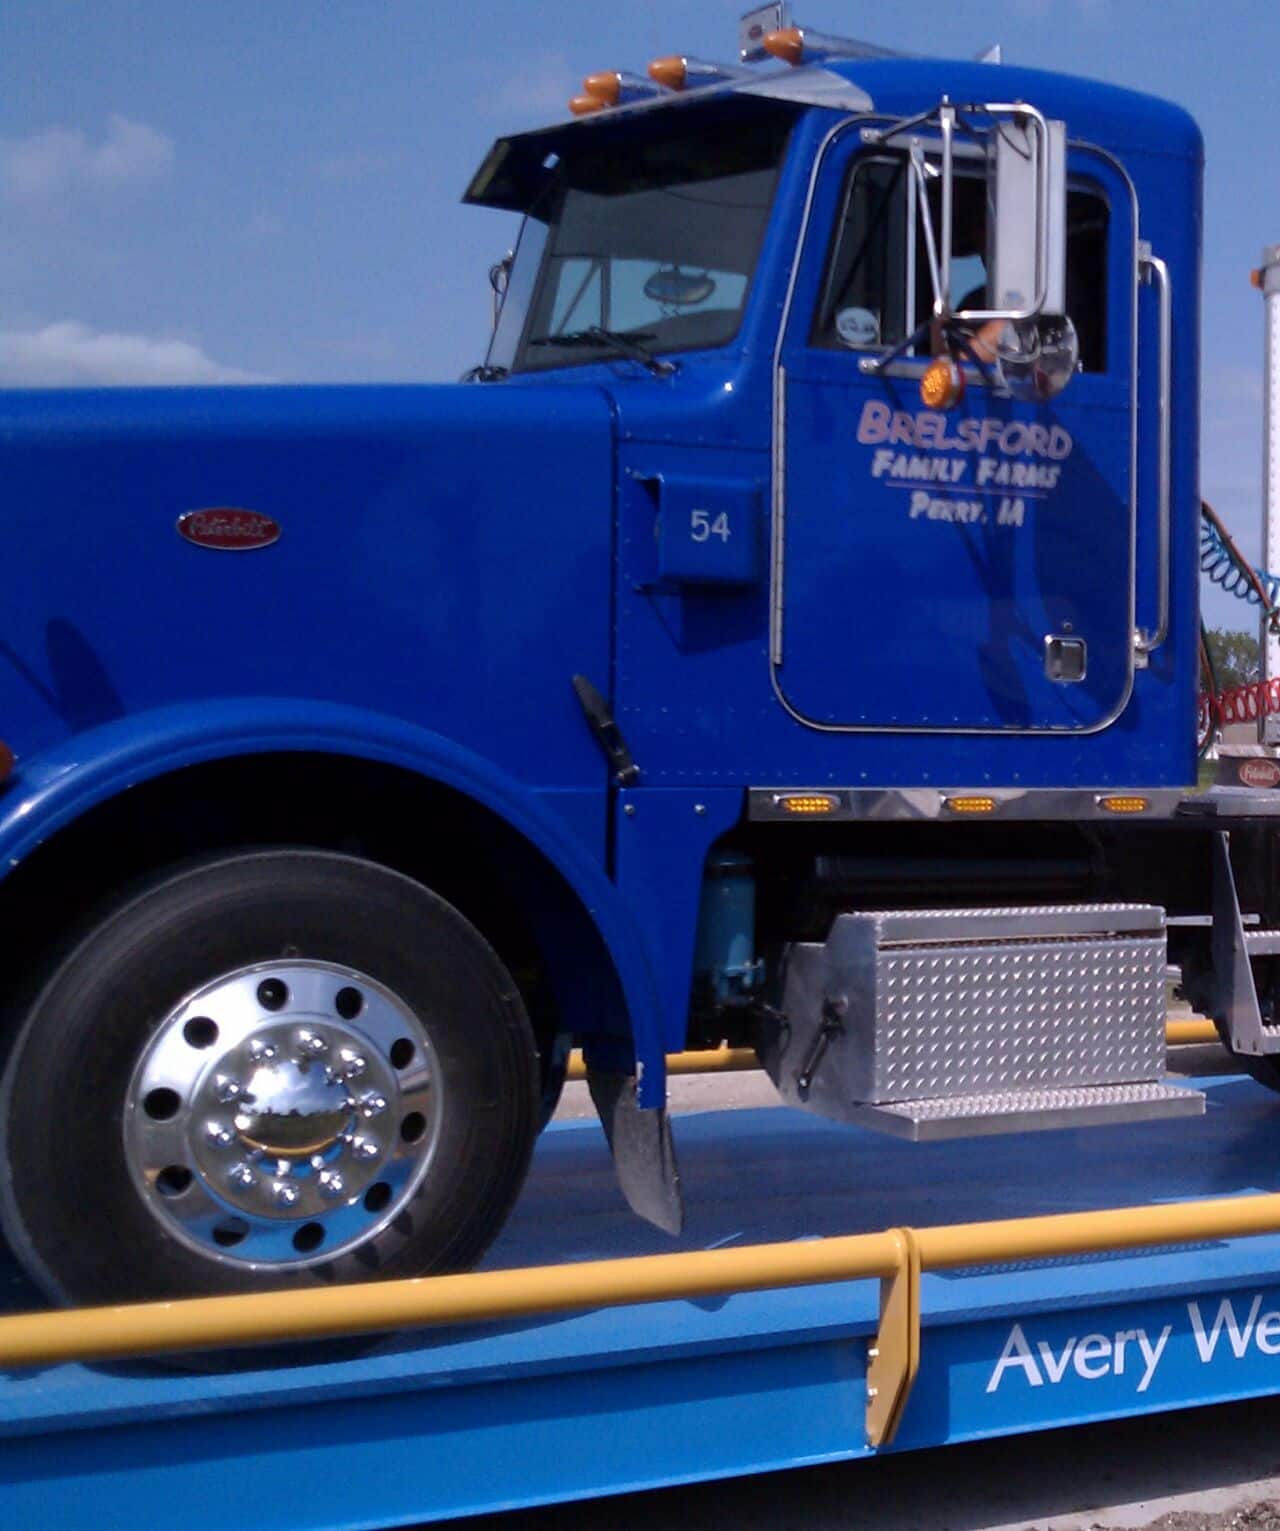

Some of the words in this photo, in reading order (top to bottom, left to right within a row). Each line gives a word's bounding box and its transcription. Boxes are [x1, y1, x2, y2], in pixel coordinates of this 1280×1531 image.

[857, 400, 1072, 460] BRELSFORD
[872, 450, 967, 482] FAMILY
[977, 459, 1061, 489] FARMS
[690, 510, 731, 543] 54
[997, 498, 1025, 527] IA
[986, 1323, 1172, 1393] Avery
